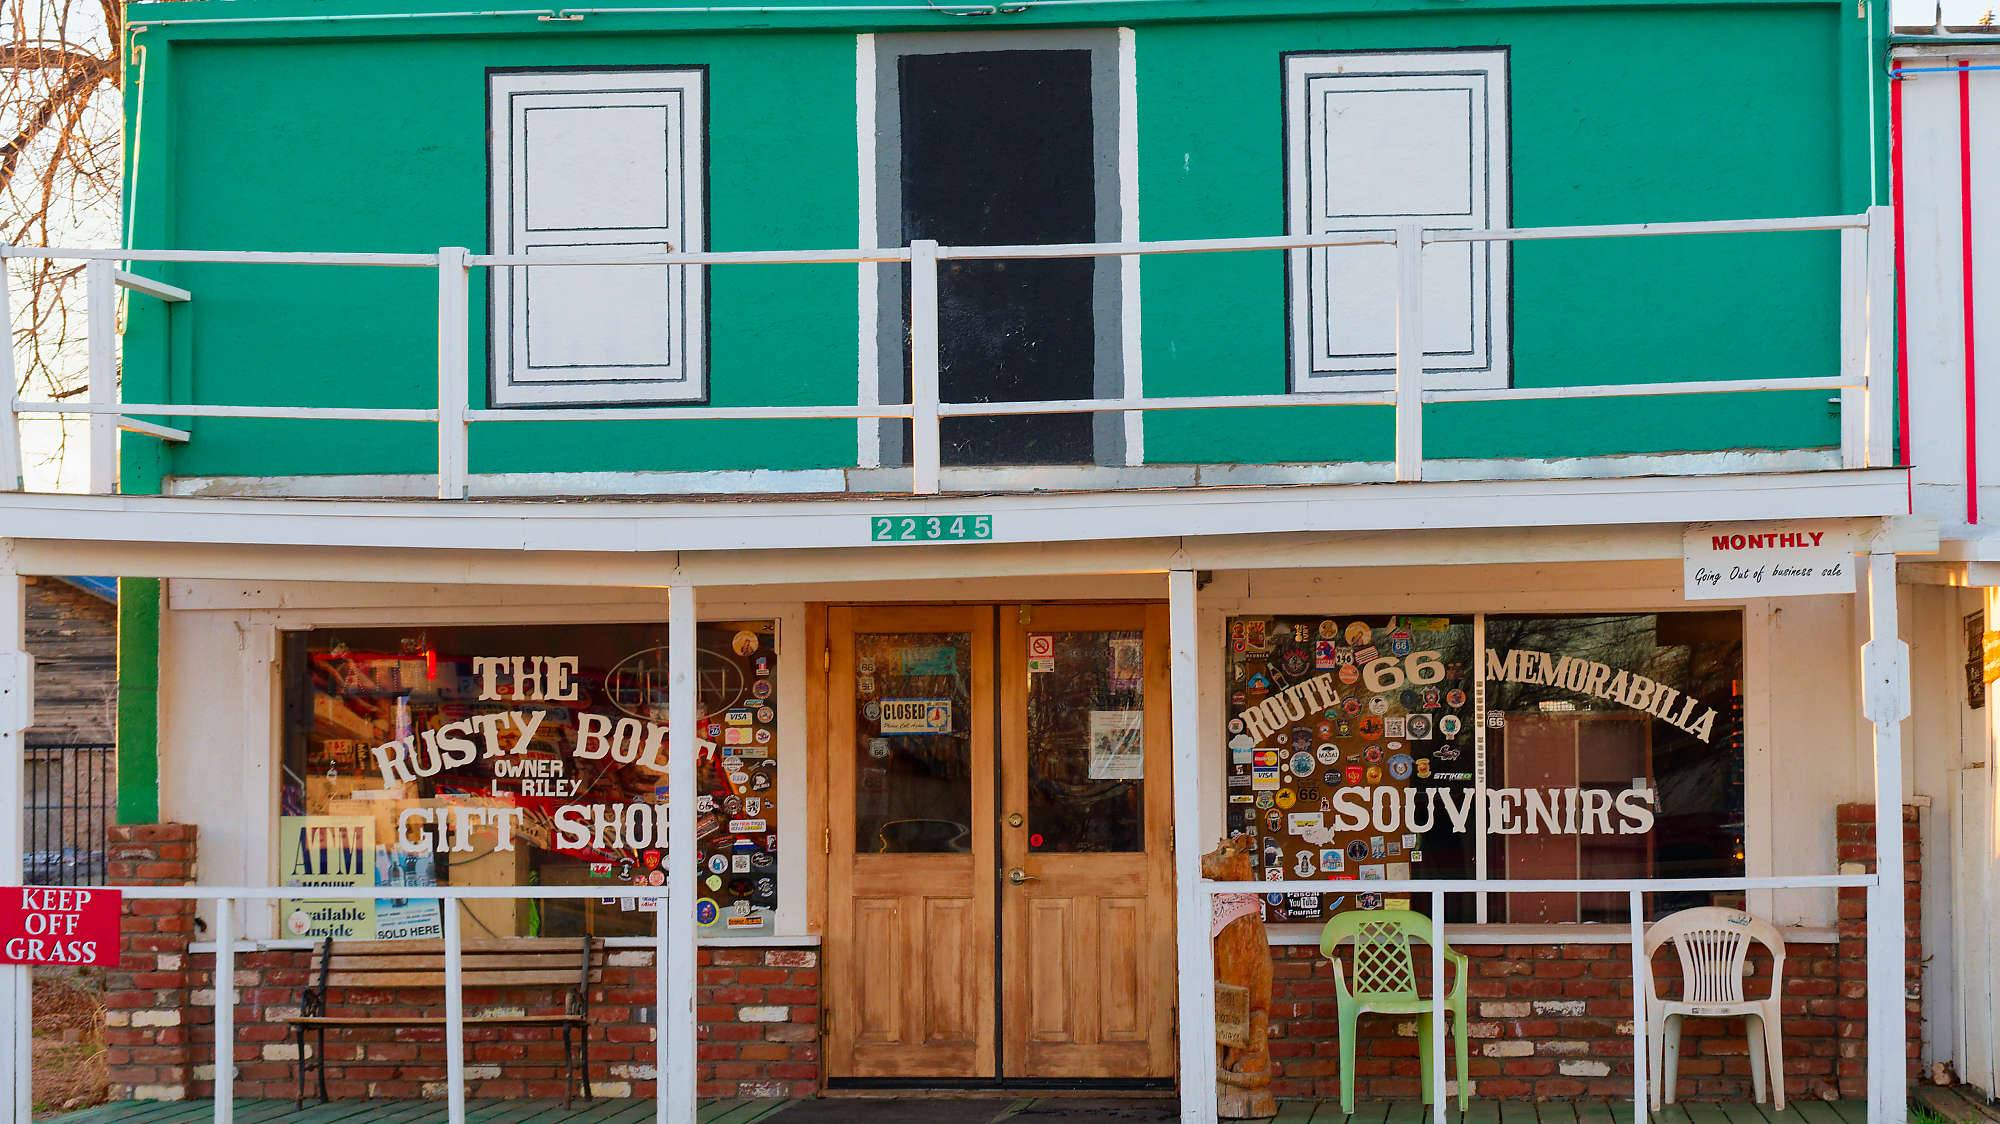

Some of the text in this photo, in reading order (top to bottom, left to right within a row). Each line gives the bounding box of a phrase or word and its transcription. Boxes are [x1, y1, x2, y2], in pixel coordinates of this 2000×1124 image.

[877, 517, 990, 540] 22345
[1712, 532, 1824, 551] MONTHLY
[1695, 563, 1842, 585] Going Out of business sale
[473, 656, 579, 701] THE
[1238, 672, 1341, 747] ROUTE
[1362, 650, 1446, 693] 66
[1486, 649, 1719, 744] MEMORABILIA
[883, 703, 926, 720] CLOSED
[1488, 717, 1504, 726] 66
[372, 710, 547, 789] RUSTY
[495, 760, 563, 777] OWNER
[522, 779, 583, 797] RILEY
[698, 801, 711, 811] 66
[1333, 787, 1655, 834] SOUVENIRS
[399, 807, 524, 852] GIFT
[292, 827, 366, 875] ATM
[21, 888, 92, 911] KEEP
[1289, 897, 1318, 908] YouTube
[25, 913, 80, 935] OFF
[377, 925, 440, 939] SOLD HERE
[5, 937, 97, 963] GRASS
